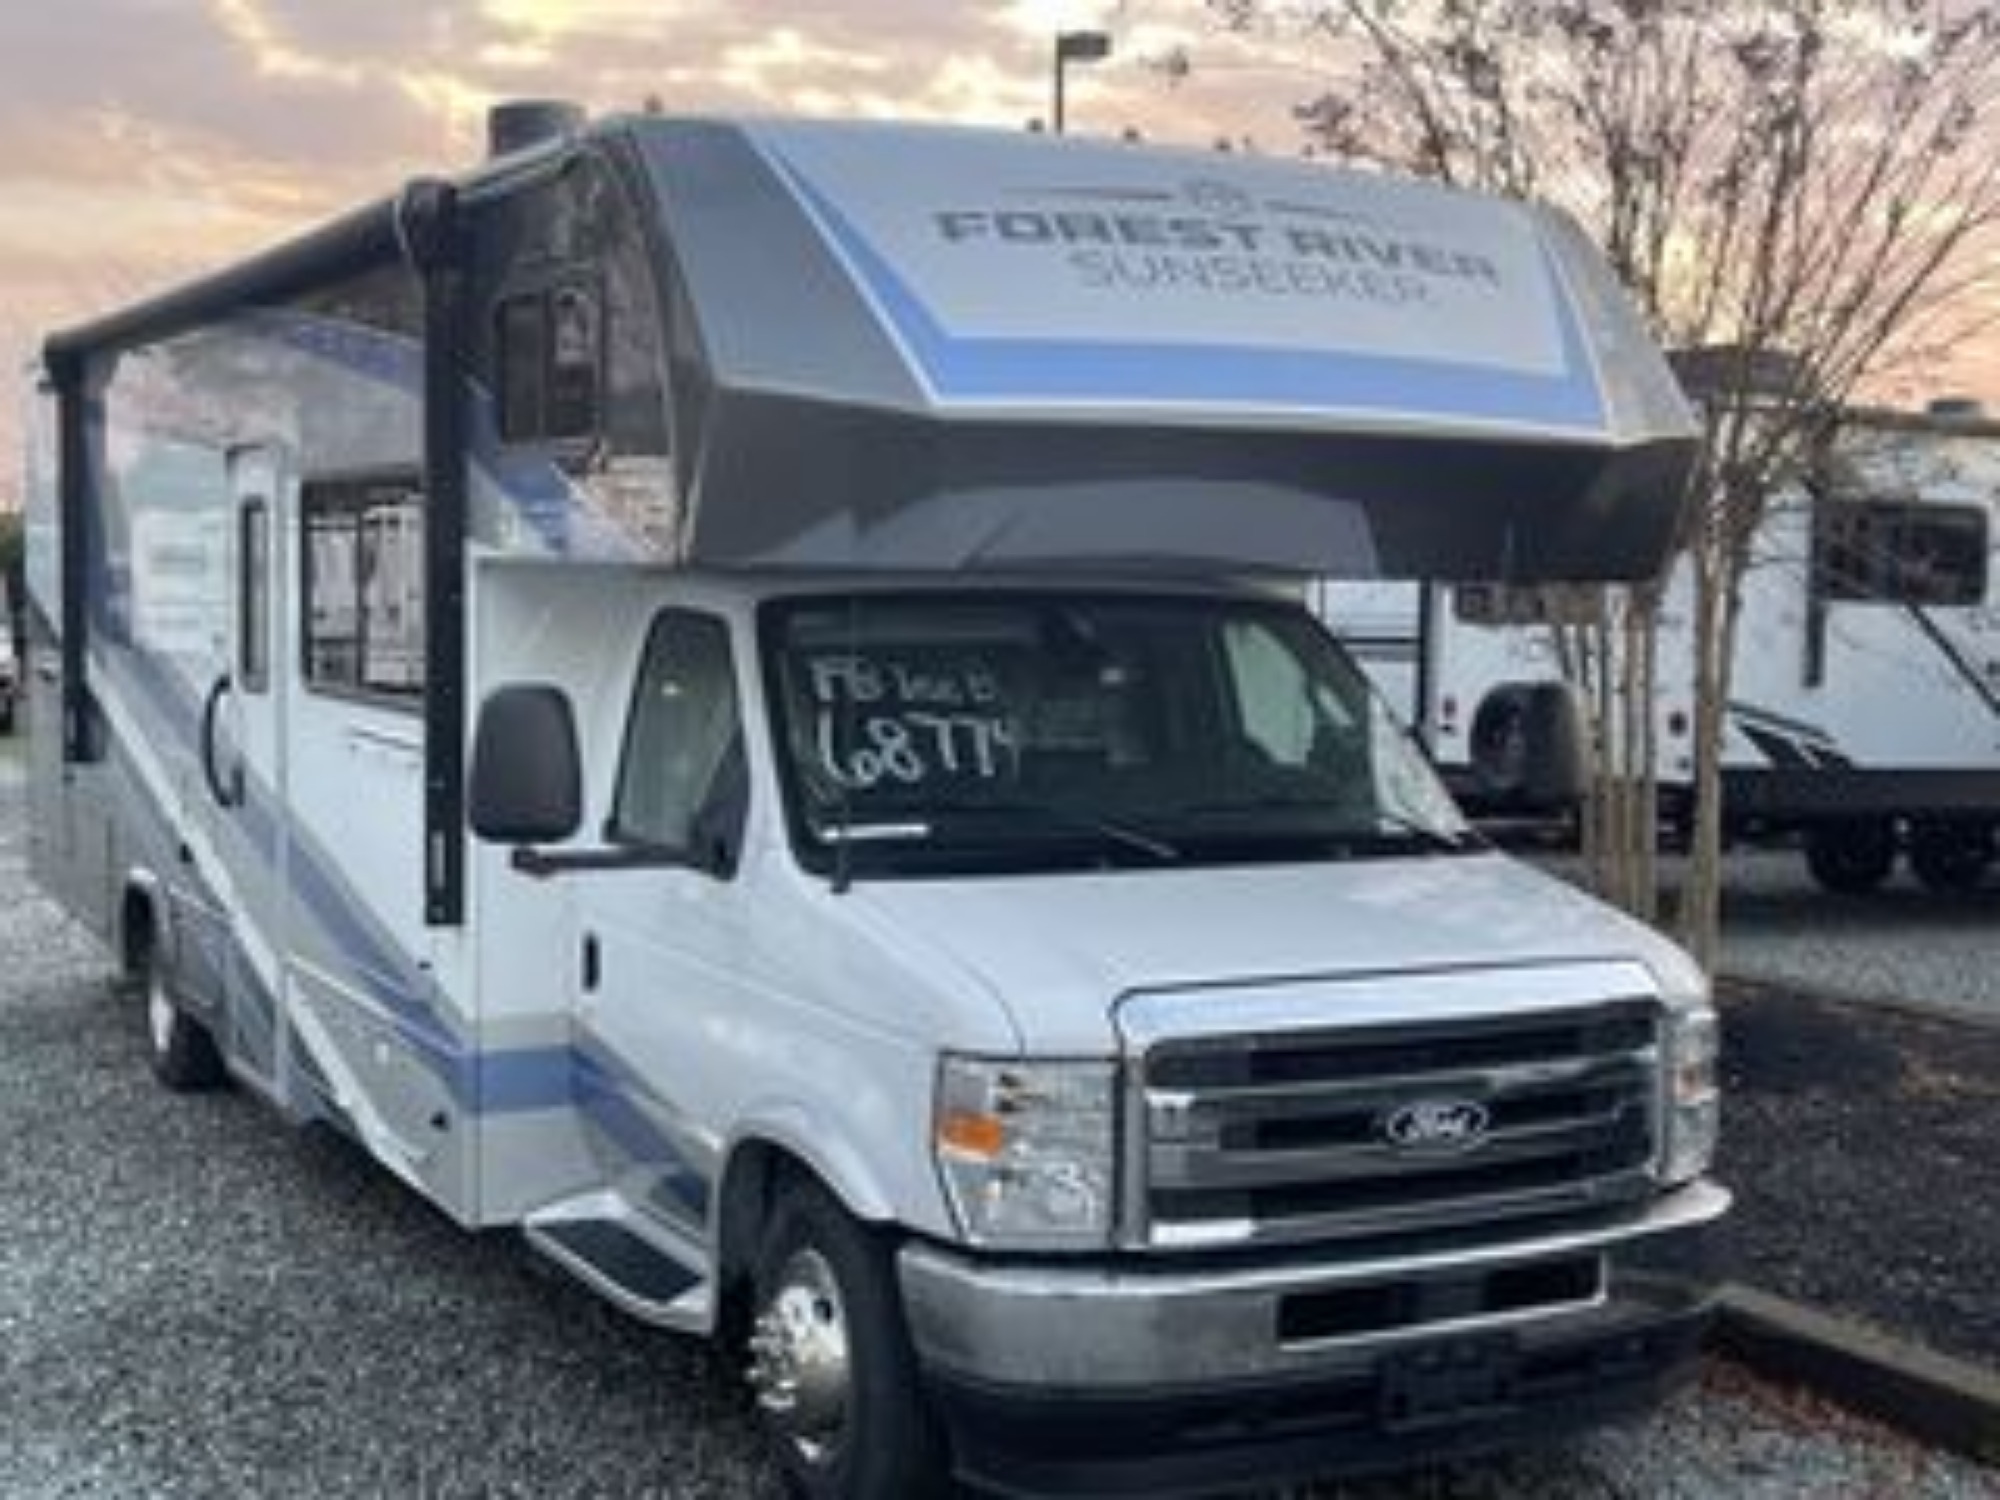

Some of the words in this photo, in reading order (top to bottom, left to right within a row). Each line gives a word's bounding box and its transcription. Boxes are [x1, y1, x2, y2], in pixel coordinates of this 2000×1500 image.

[935, 211, 1264, 252] FOREST
[1286, 228, 1497, 284] RIVER
[1068, 249, 1432, 304] SUNSEEKER
[1401, 1107, 1477, 1143] Ford
